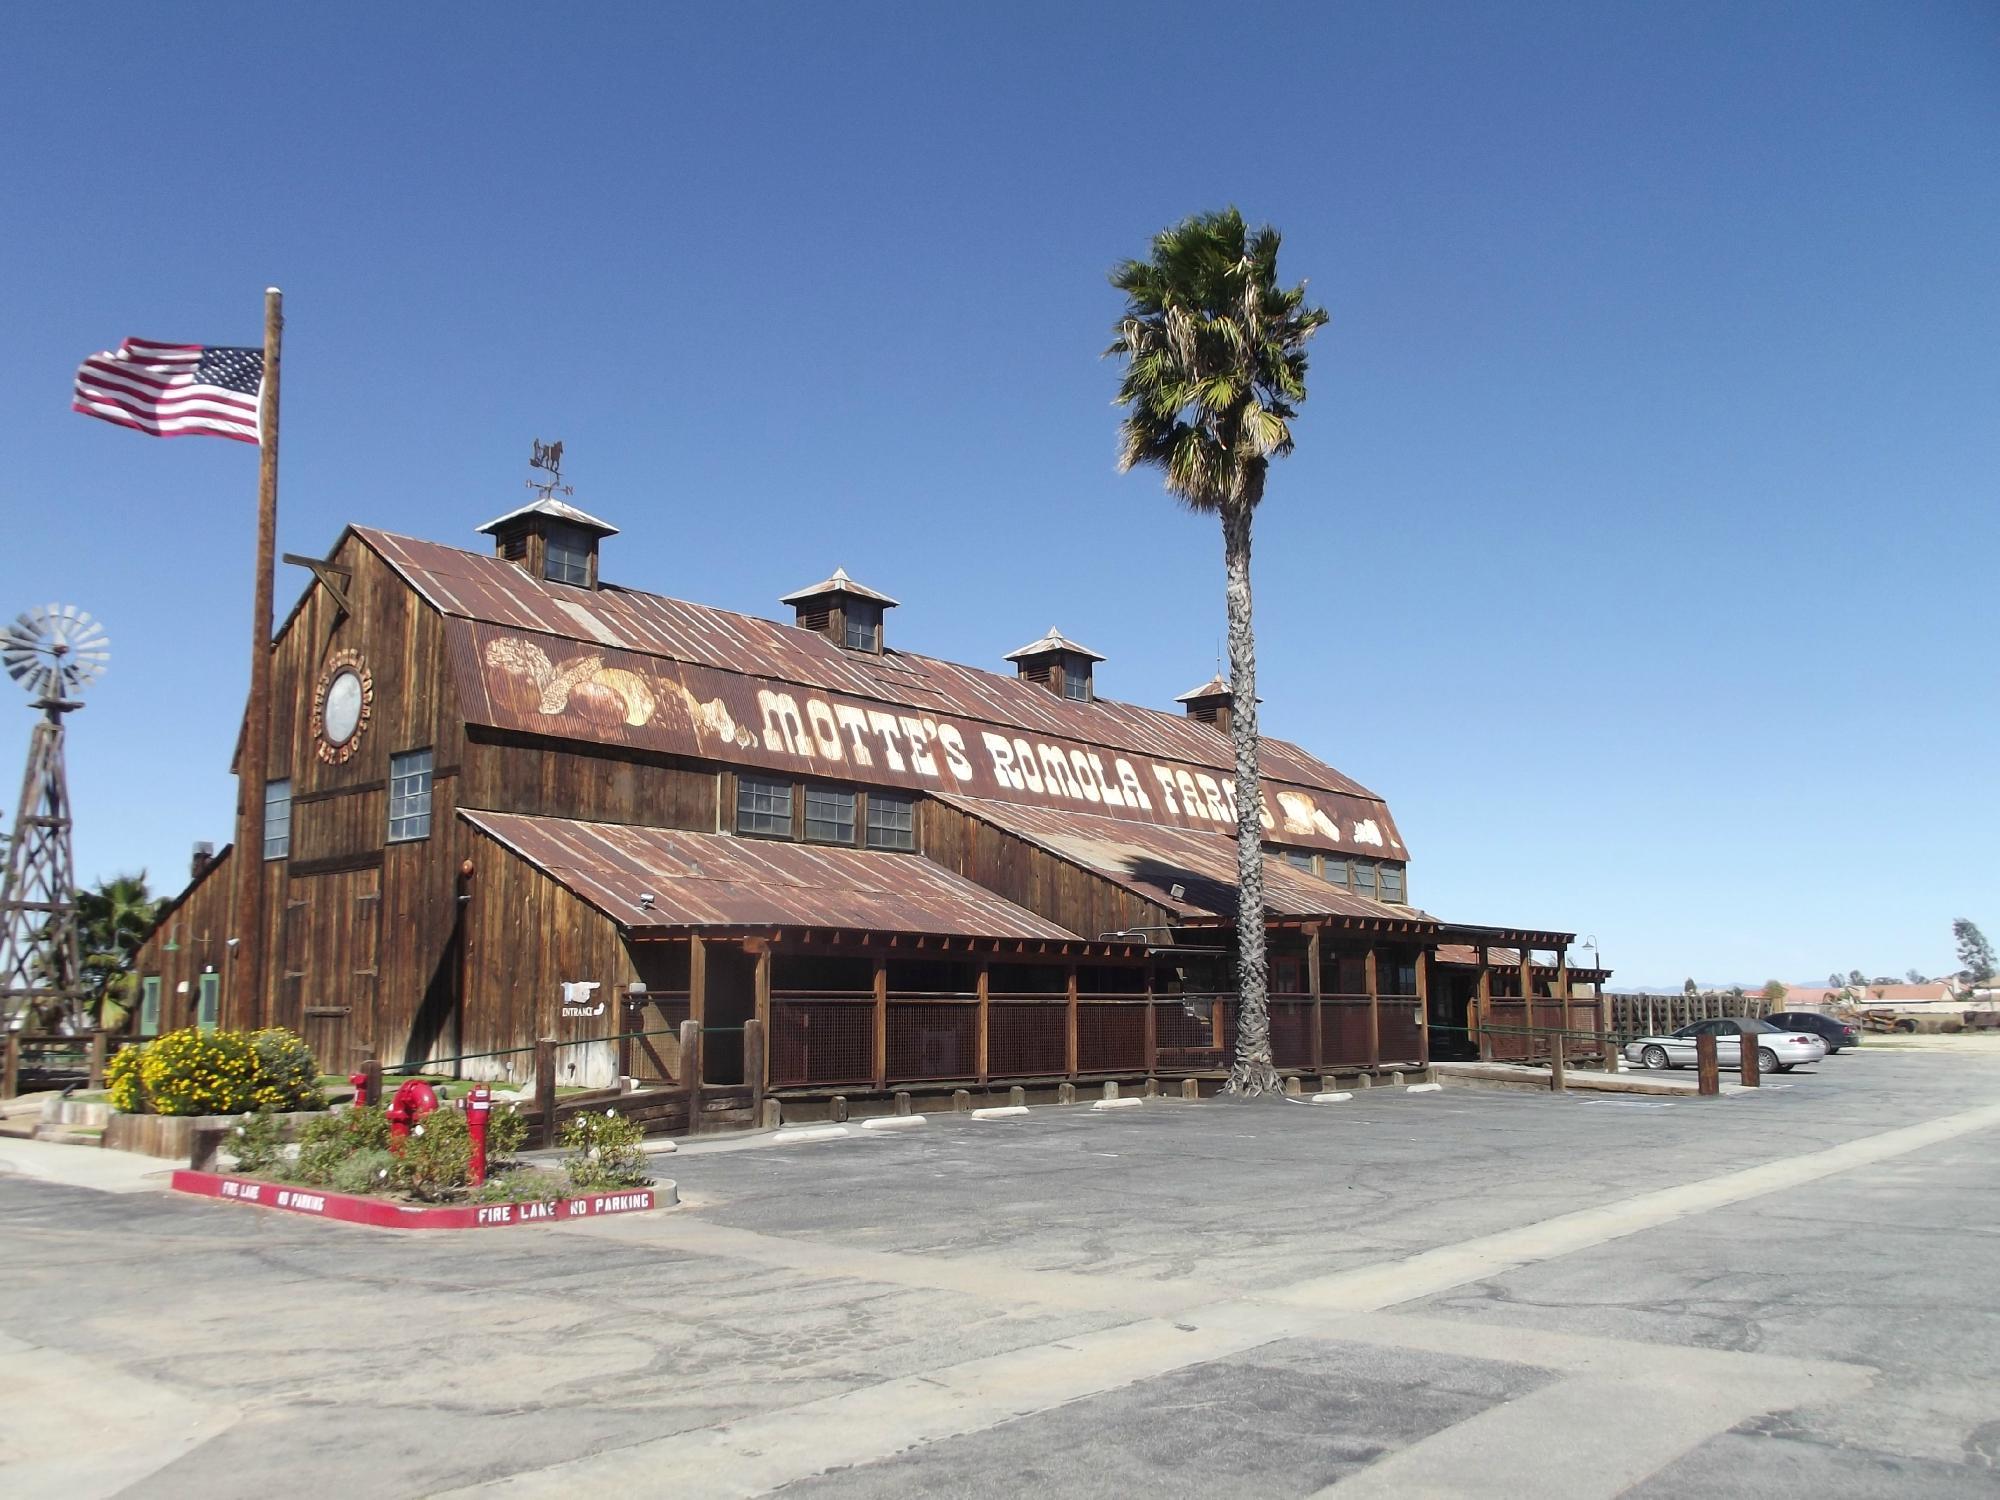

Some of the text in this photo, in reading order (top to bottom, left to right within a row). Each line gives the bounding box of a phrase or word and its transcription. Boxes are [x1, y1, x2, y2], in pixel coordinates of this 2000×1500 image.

[758, 689, 973, 781] MOTTE'S
[981, 731, 1153, 810] ROMOLA
[562, 1007, 593, 1017] ENTRANCE
[478, 1193, 649, 1223] FIRE LANE NO PARKING
